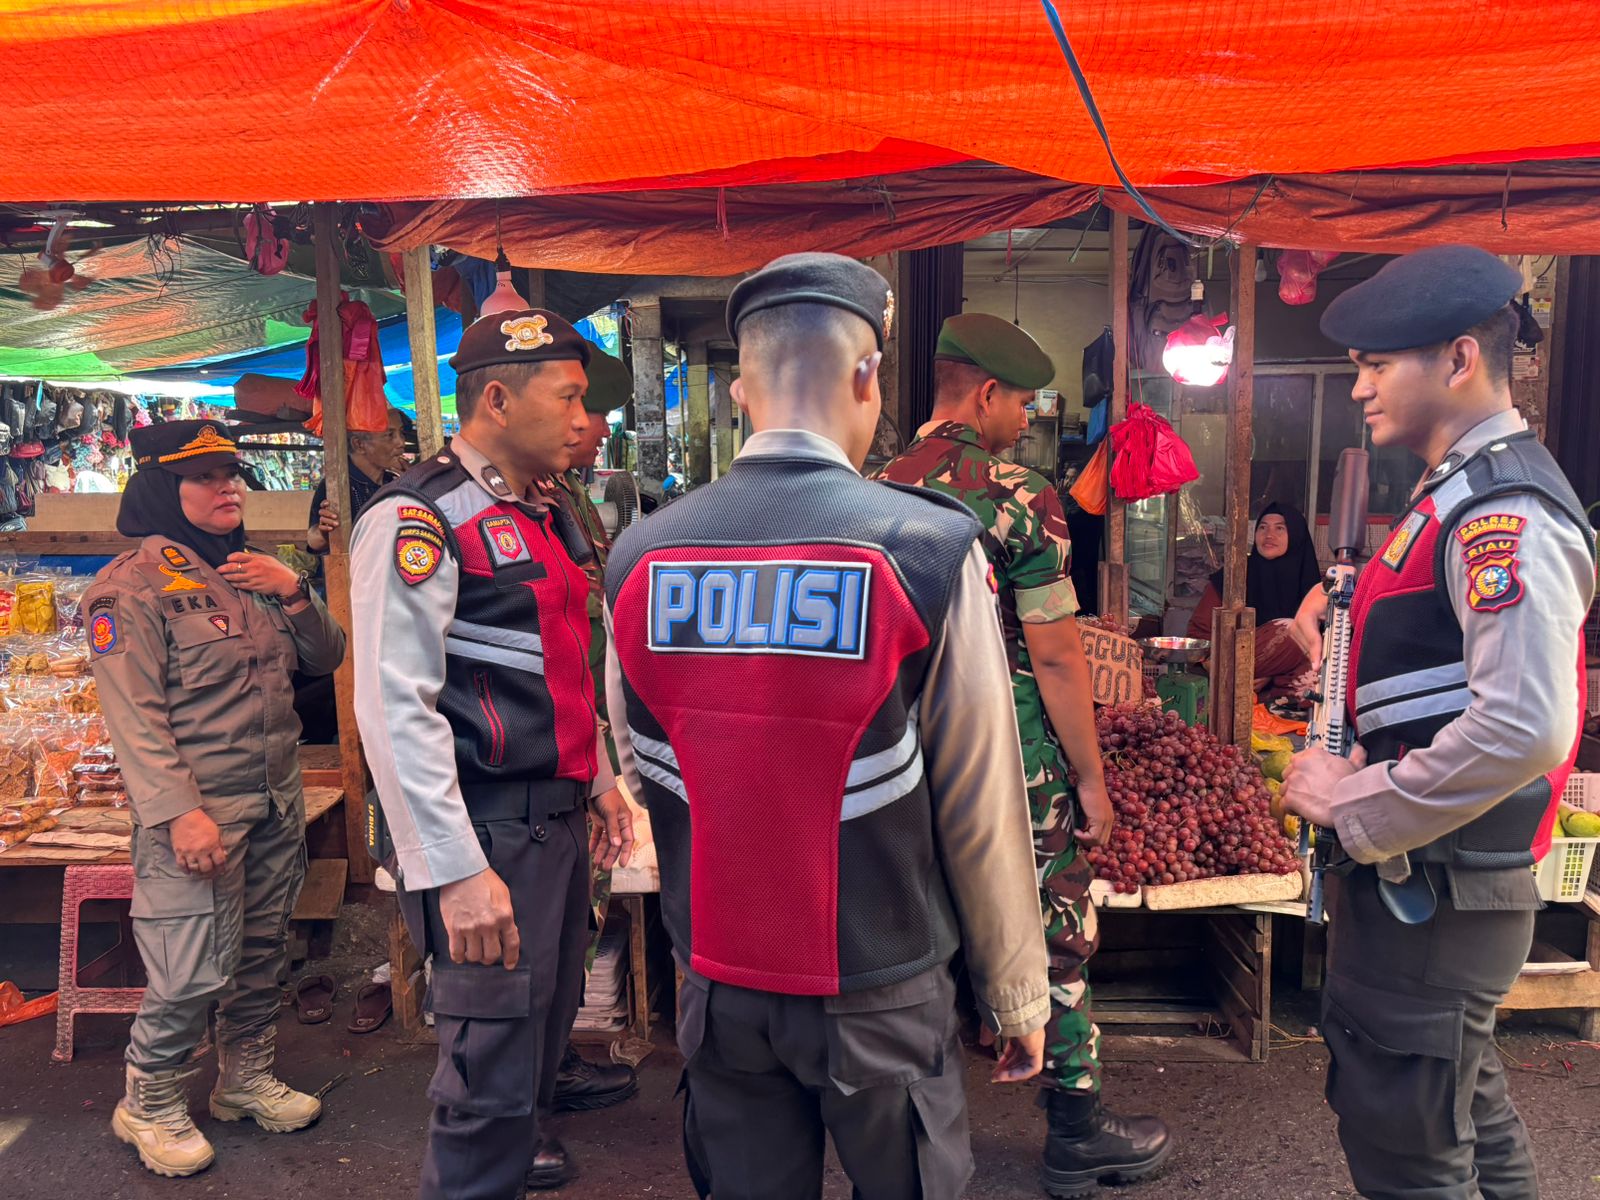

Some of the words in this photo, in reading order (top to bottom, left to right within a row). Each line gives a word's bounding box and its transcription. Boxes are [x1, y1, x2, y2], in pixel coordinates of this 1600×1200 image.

[1460, 516, 1519, 535] POLRES
[1468, 541, 1511, 558] RIAU
[172, 595, 218, 613] EKA
[655, 569, 862, 650] POLISI
